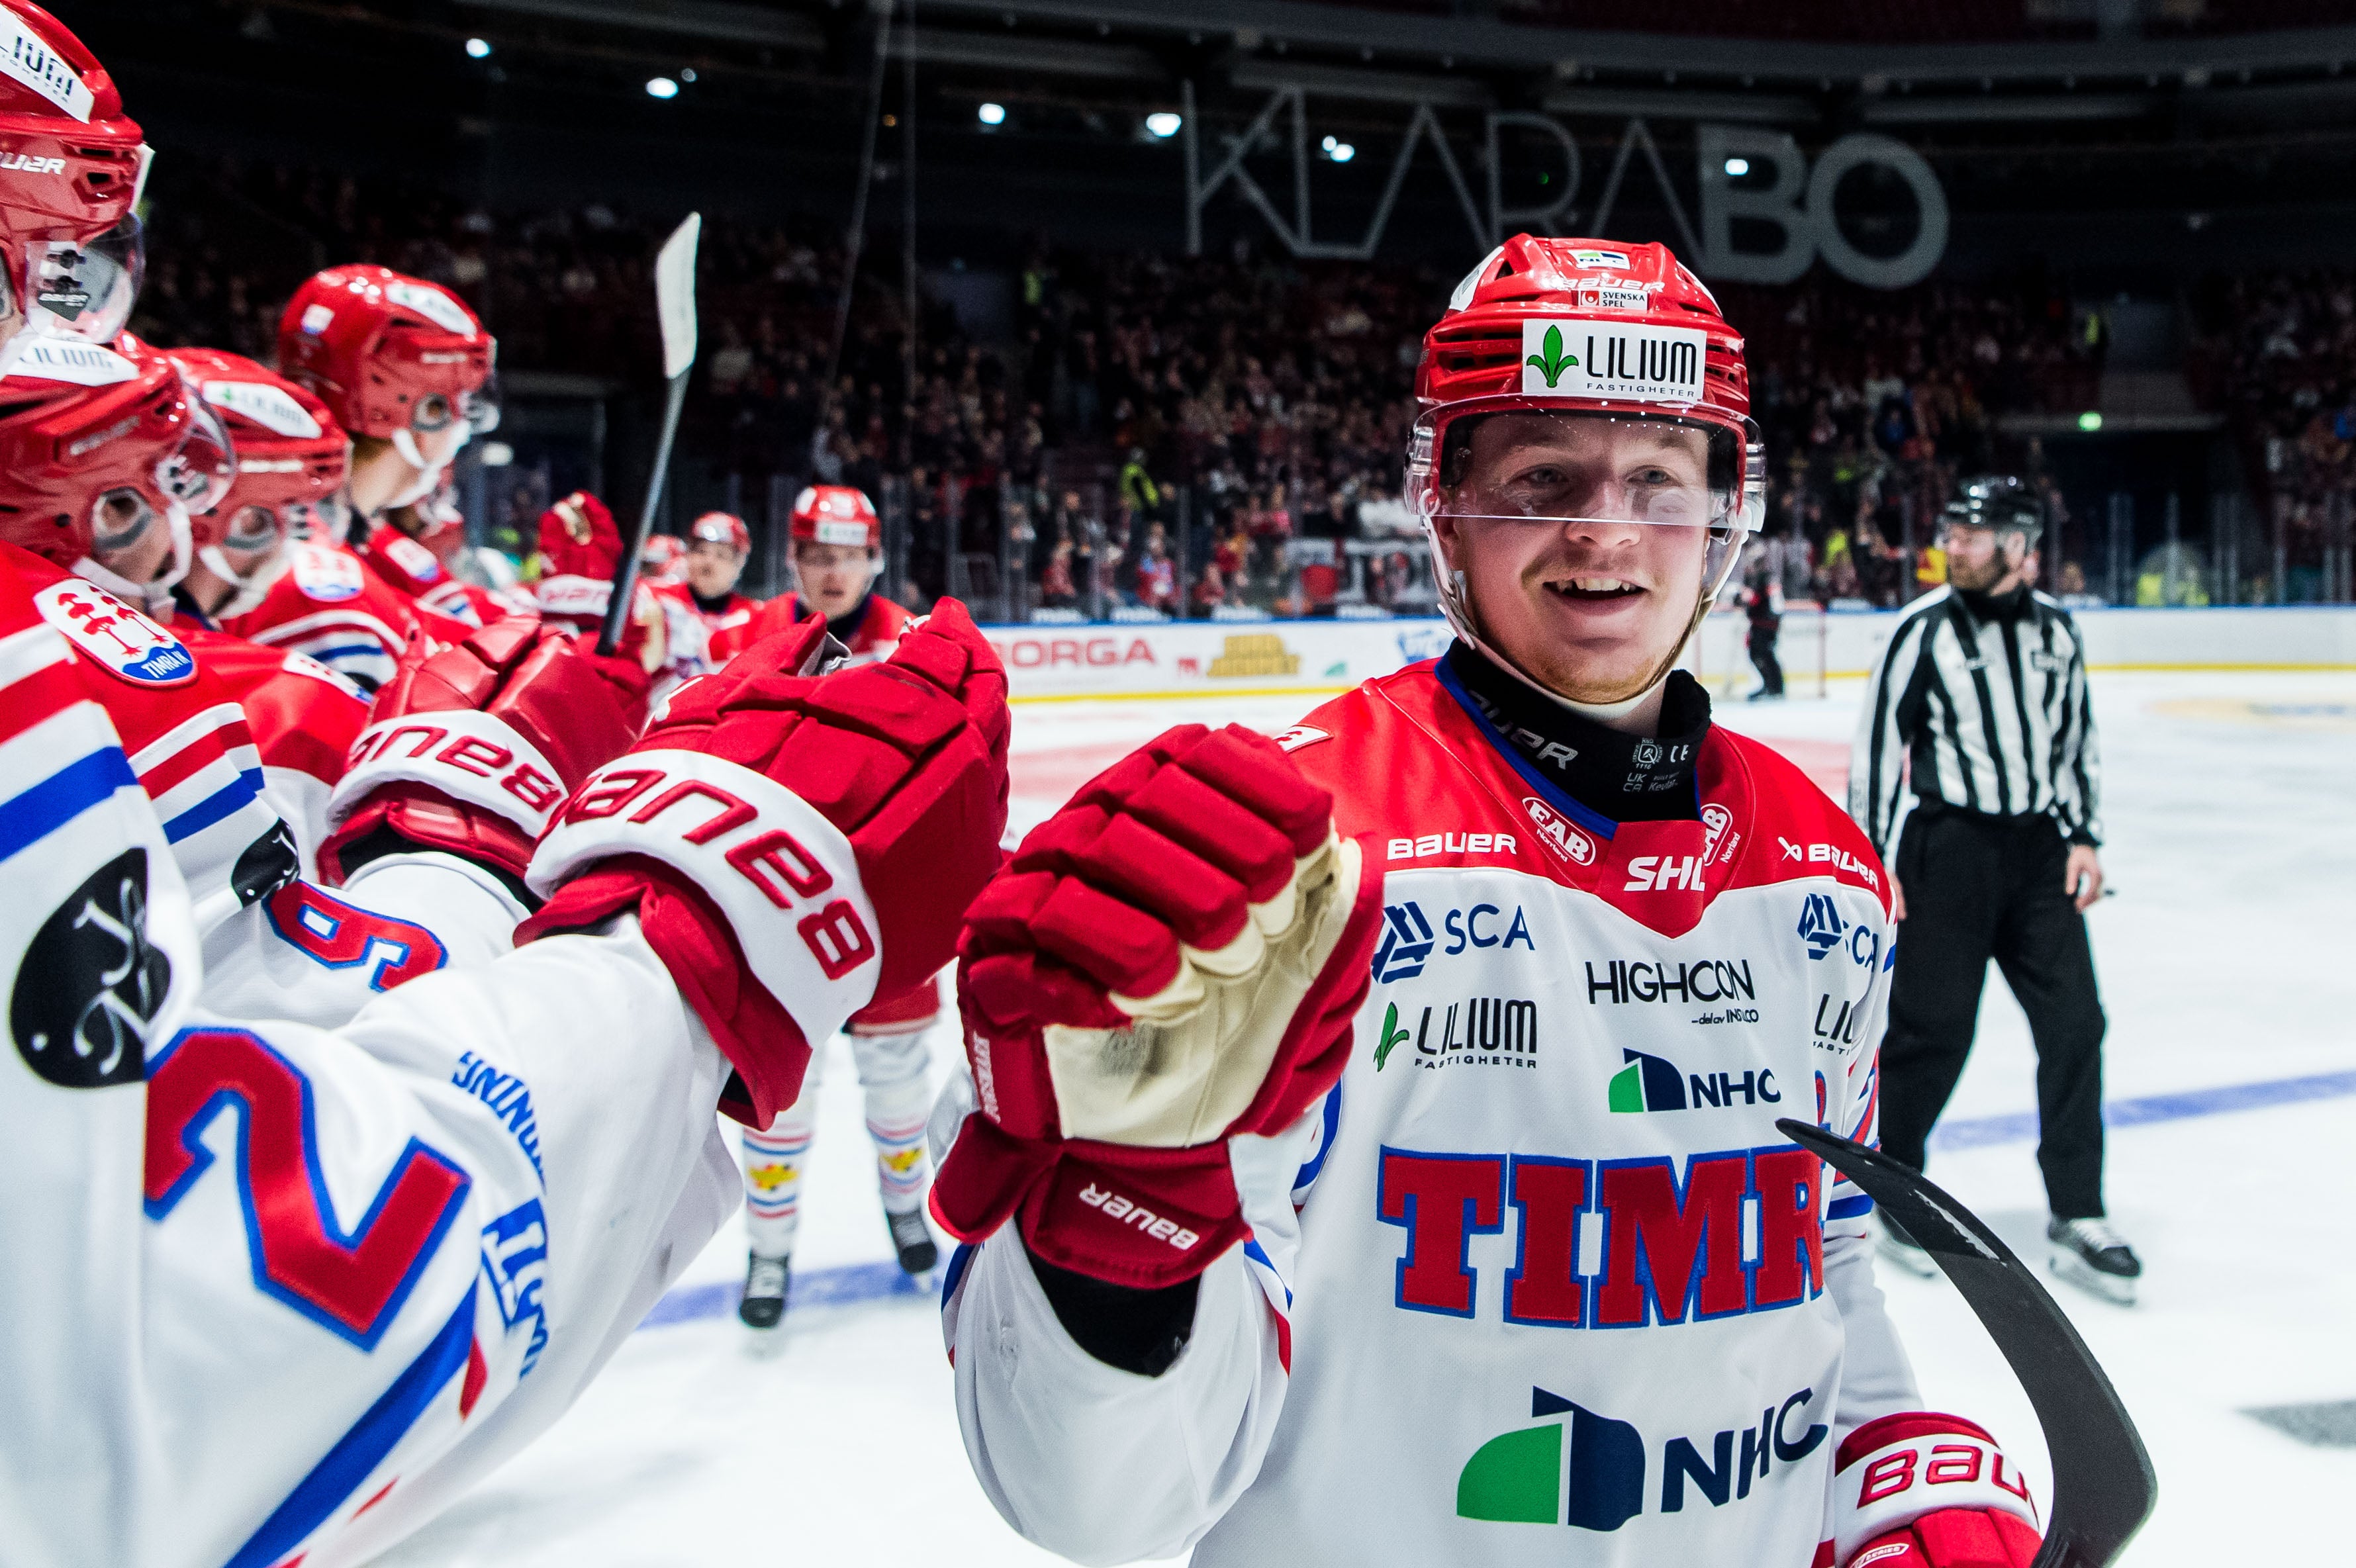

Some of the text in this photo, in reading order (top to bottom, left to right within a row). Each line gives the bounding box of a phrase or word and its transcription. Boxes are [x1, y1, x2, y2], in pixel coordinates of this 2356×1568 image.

[0, 152, 66, 175] UER
[1603, 291, 1645, 302] SVENSKA
[1603, 299, 1625, 308] SPEL
[1587, 336, 1697, 385] LILIUM
[1587, 383, 1695, 397] FASTIGHETER
[995, 638, 1157, 669] ORGA
[1468, 689, 1579, 770] AUER
[1387, 832, 1517, 860] BAUER
[1529, 801, 1589, 861] EAB
[1536, 828, 1568, 863] Norrland
[1703, 808, 1728, 862] AB
[1720, 831, 1742, 864] Norrland
[1623, 856, 1706, 892] SHL
[1808, 843, 1879, 892] BAUER
[1444, 903, 1536, 955] SCA
[1585, 959, 1756, 1004] HIGHCON
[1417, 997, 1537, 1055] LILIUM
[1414, 1055, 1536, 1070] FASTIGHETER
[1689, 1068, 1782, 1109] NHC
[144, 1027, 472, 1355] 2
[1079, 1182, 1200, 1250] BAUER
[1376, 1145, 1824, 1330] TIMR
[1660, 1387, 1829, 1513] NHC
[1856, 1444, 2030, 1510] BAU
